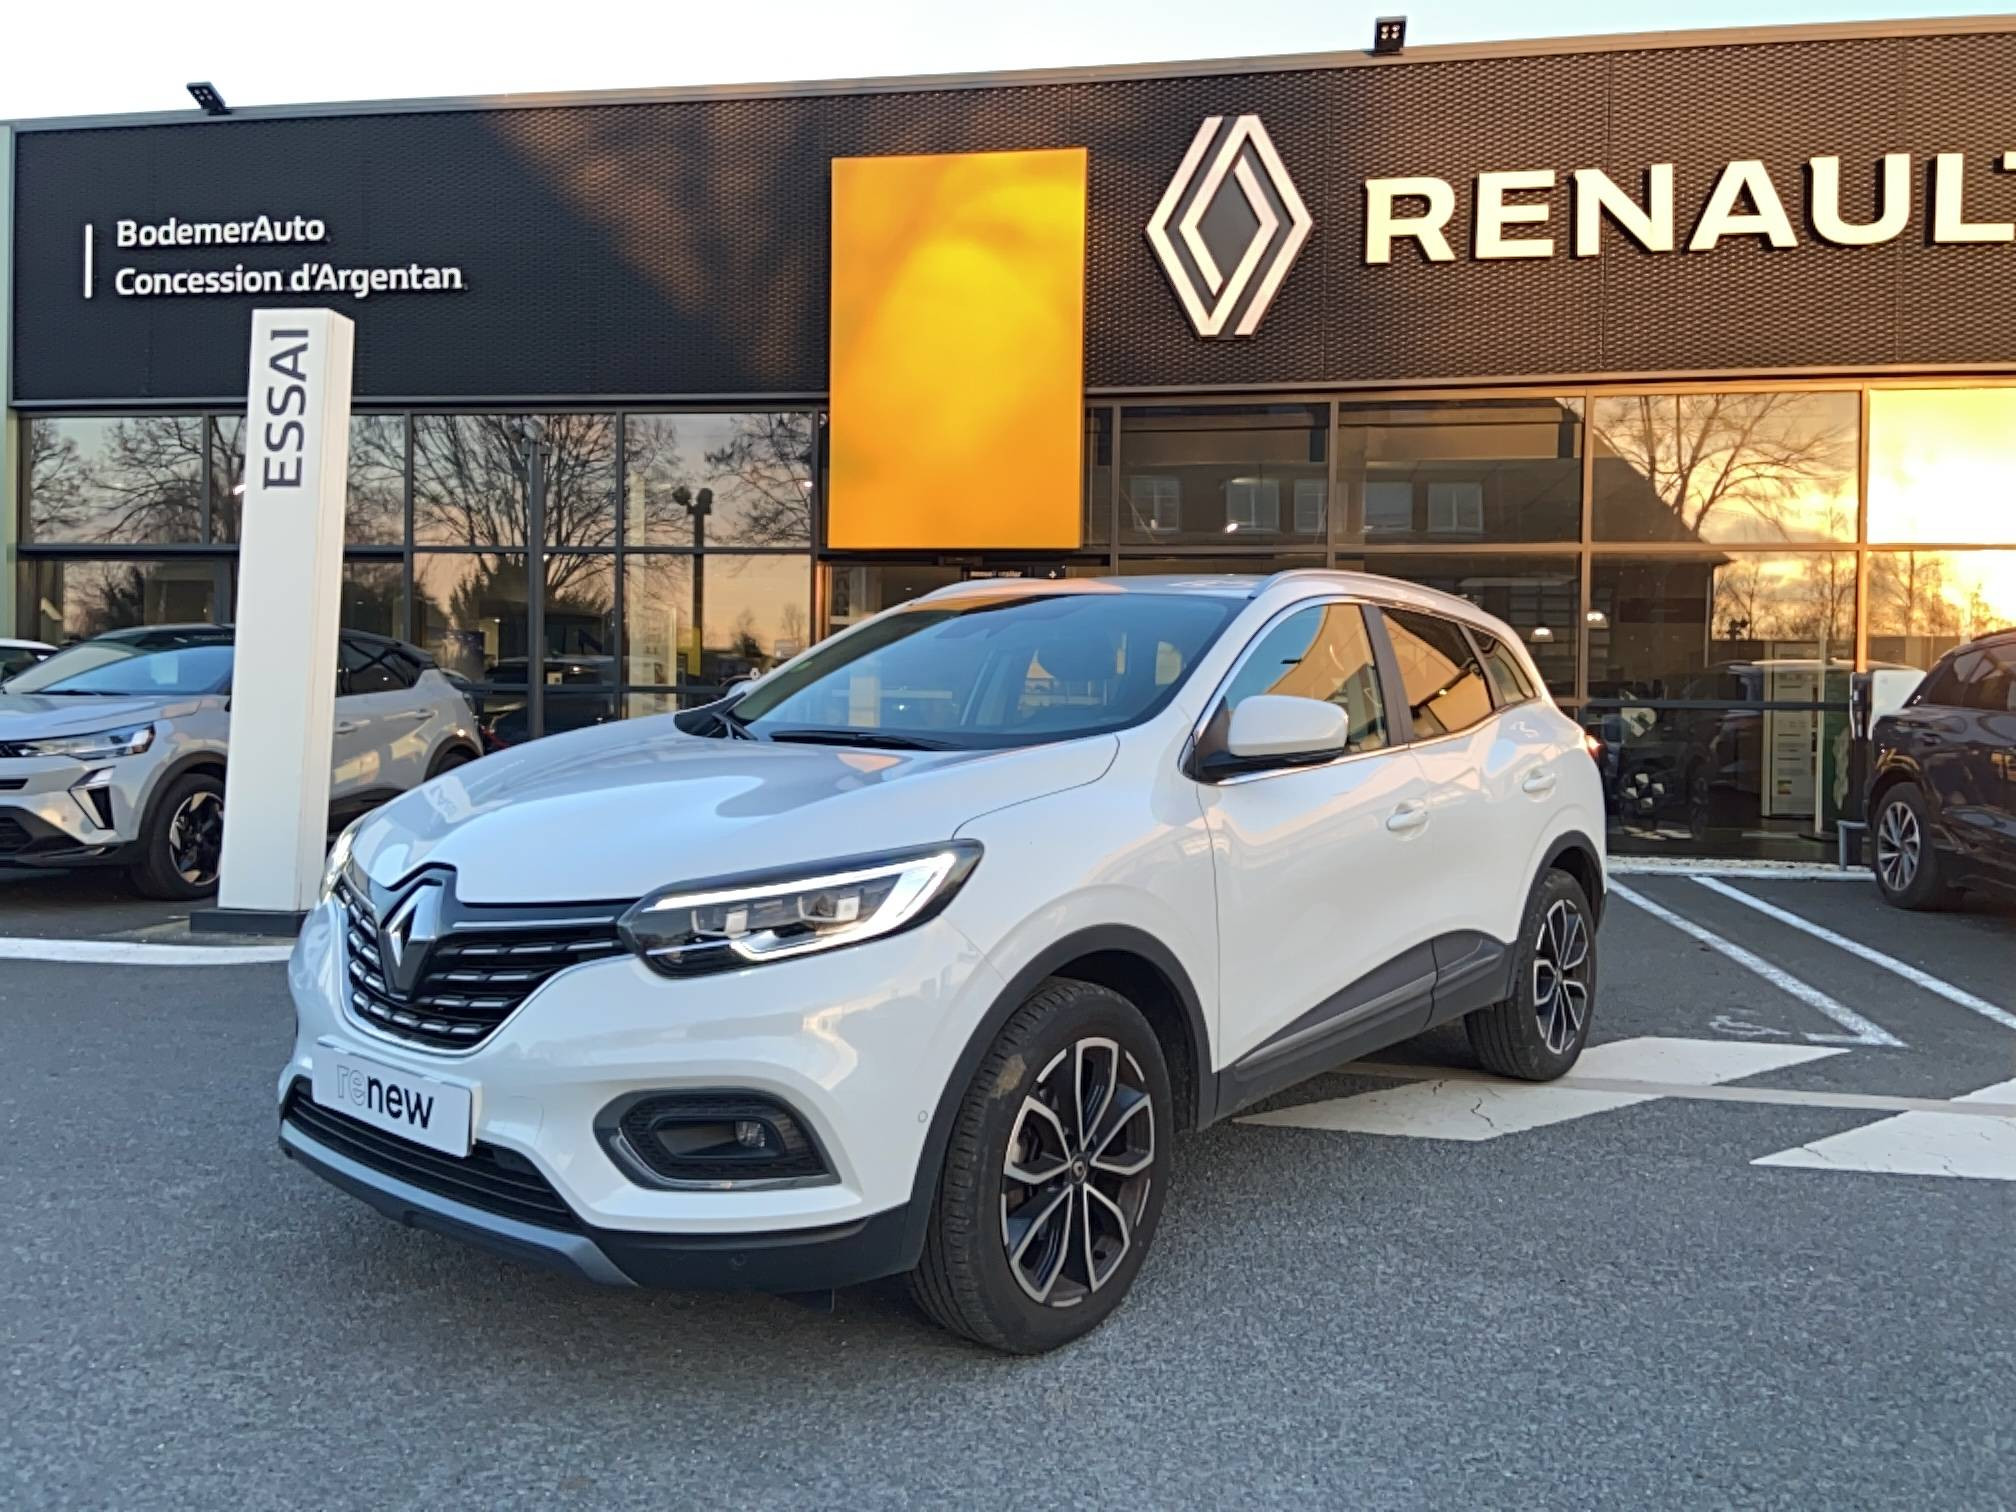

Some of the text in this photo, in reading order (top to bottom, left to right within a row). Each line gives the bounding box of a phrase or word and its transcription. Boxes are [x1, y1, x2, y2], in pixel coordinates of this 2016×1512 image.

[116, 215, 326, 247] BodemerAuto
[1365, 151, 2016, 266] RENAUL
[115, 263, 463, 298] Concession d'Argentan
[263, 329, 309, 489] ESSAI
[336, 1064, 434, 1129] renew
